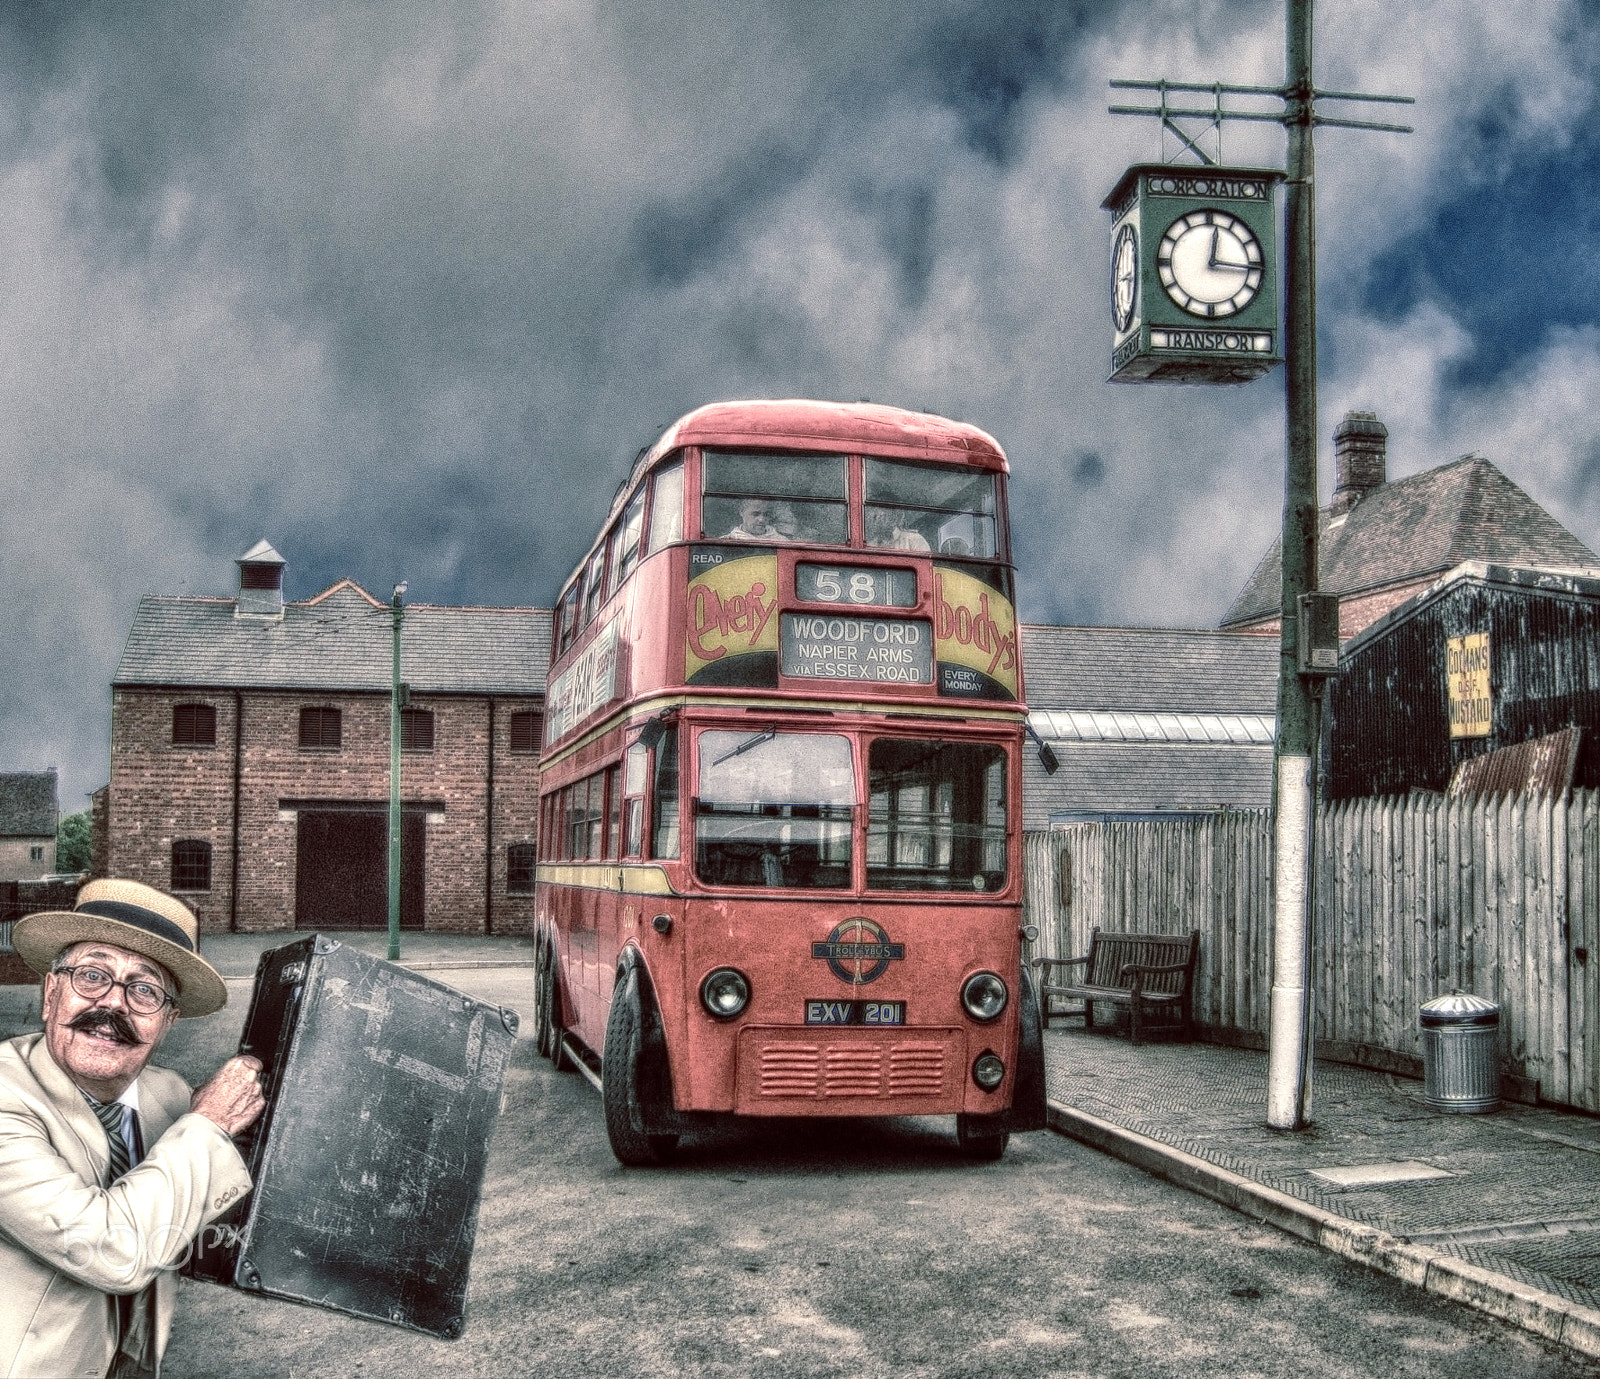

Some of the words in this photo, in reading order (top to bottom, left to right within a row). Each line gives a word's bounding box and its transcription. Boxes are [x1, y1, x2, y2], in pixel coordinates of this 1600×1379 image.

[1149, 178, 1267, 198] CORPORATION
[1165, 332, 1257, 351] TRANSPORT
[692, 554, 723, 564] READ
[815, 570, 893, 606] 581
[793, 617, 920, 645] WOODFORD
[799, 643, 858, 661] NAPIER
[866, 647, 914, 663] ARMS
[793, 665, 811, 676] VIA
[814, 662, 870, 679] ESSEX
[876, 665, 920, 681] ROAD
[944, 670, 978, 681] EVERY
[945, 680, 983, 692] MONDAY
[1449, 697, 1490, 725] MUSTARD
[808, 1003, 851, 1022] EXV
[865, 1003, 900, 1022] 201
